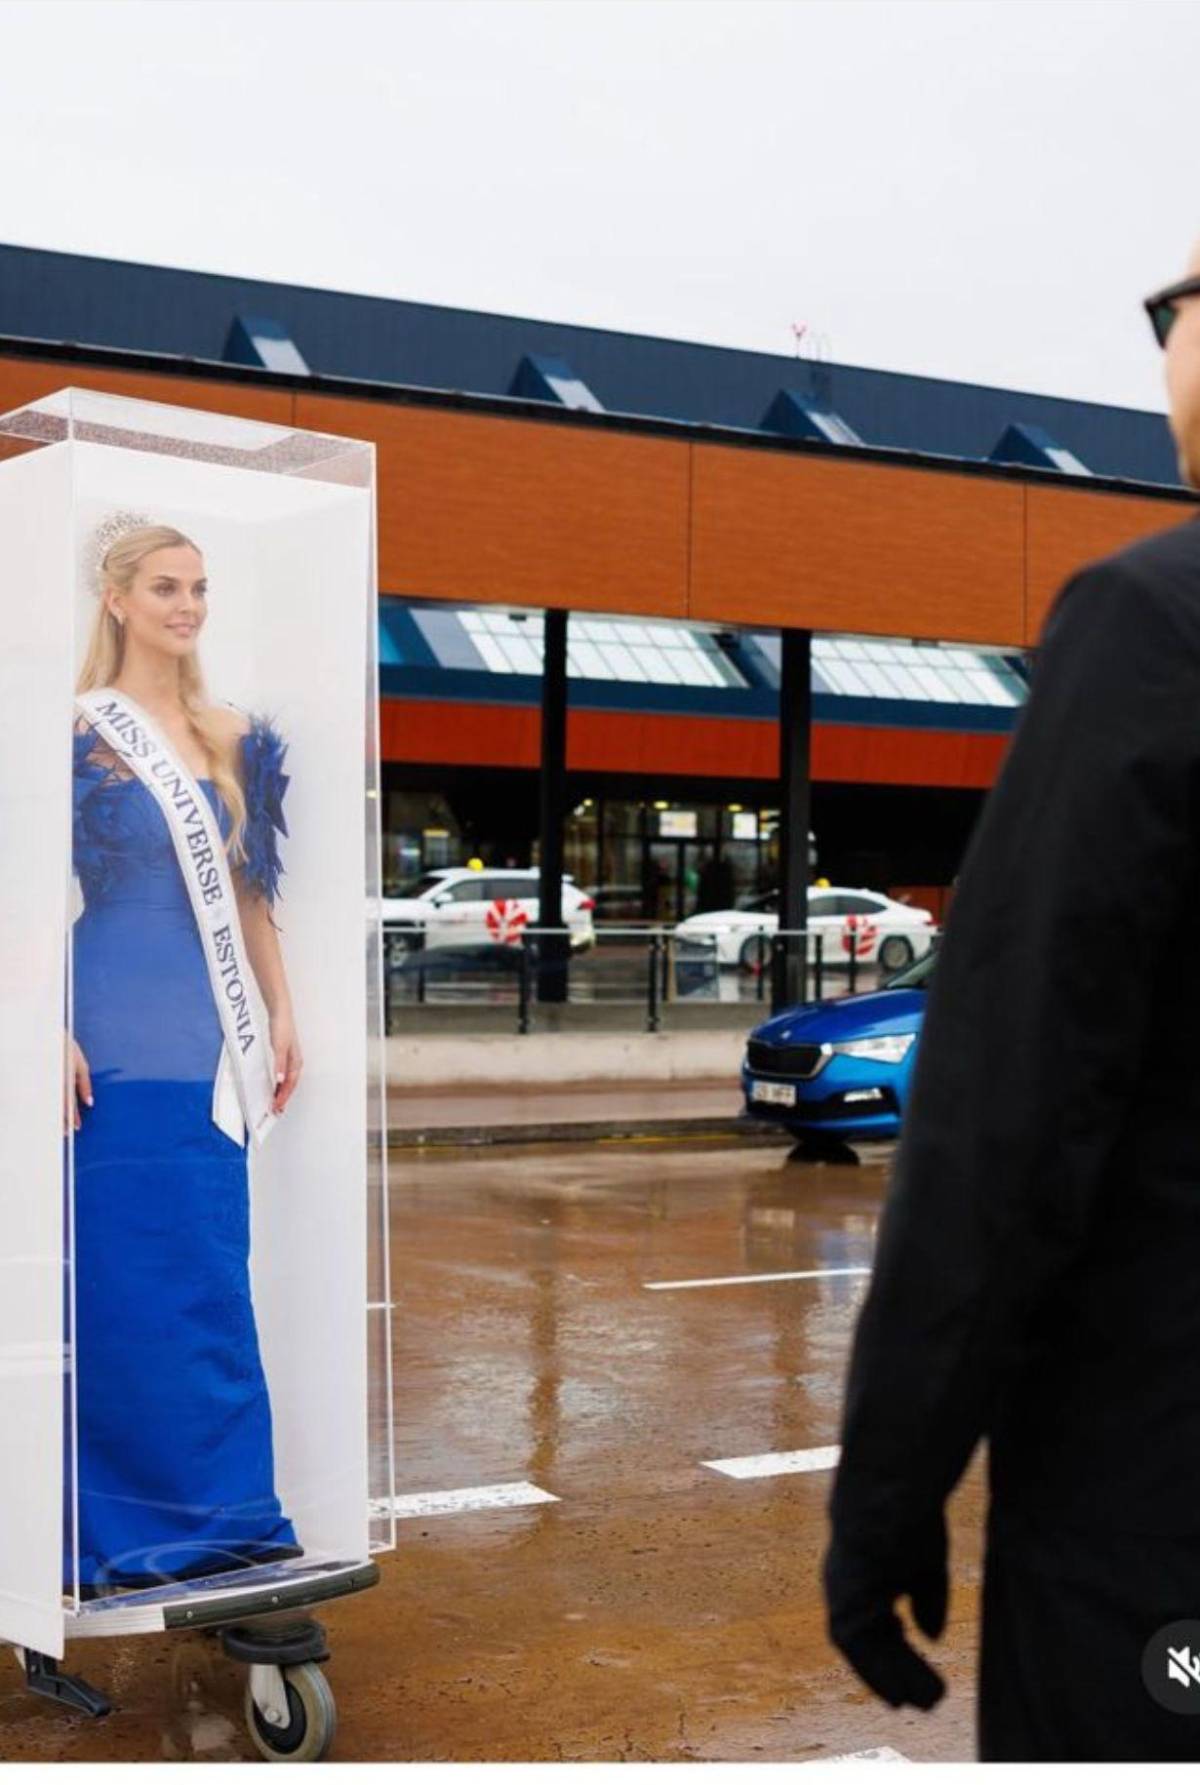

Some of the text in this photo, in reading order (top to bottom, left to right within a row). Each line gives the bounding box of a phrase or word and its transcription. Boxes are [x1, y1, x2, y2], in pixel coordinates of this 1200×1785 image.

[95, 701, 256, 1055] MISS UNIVERSE ESTONIA
